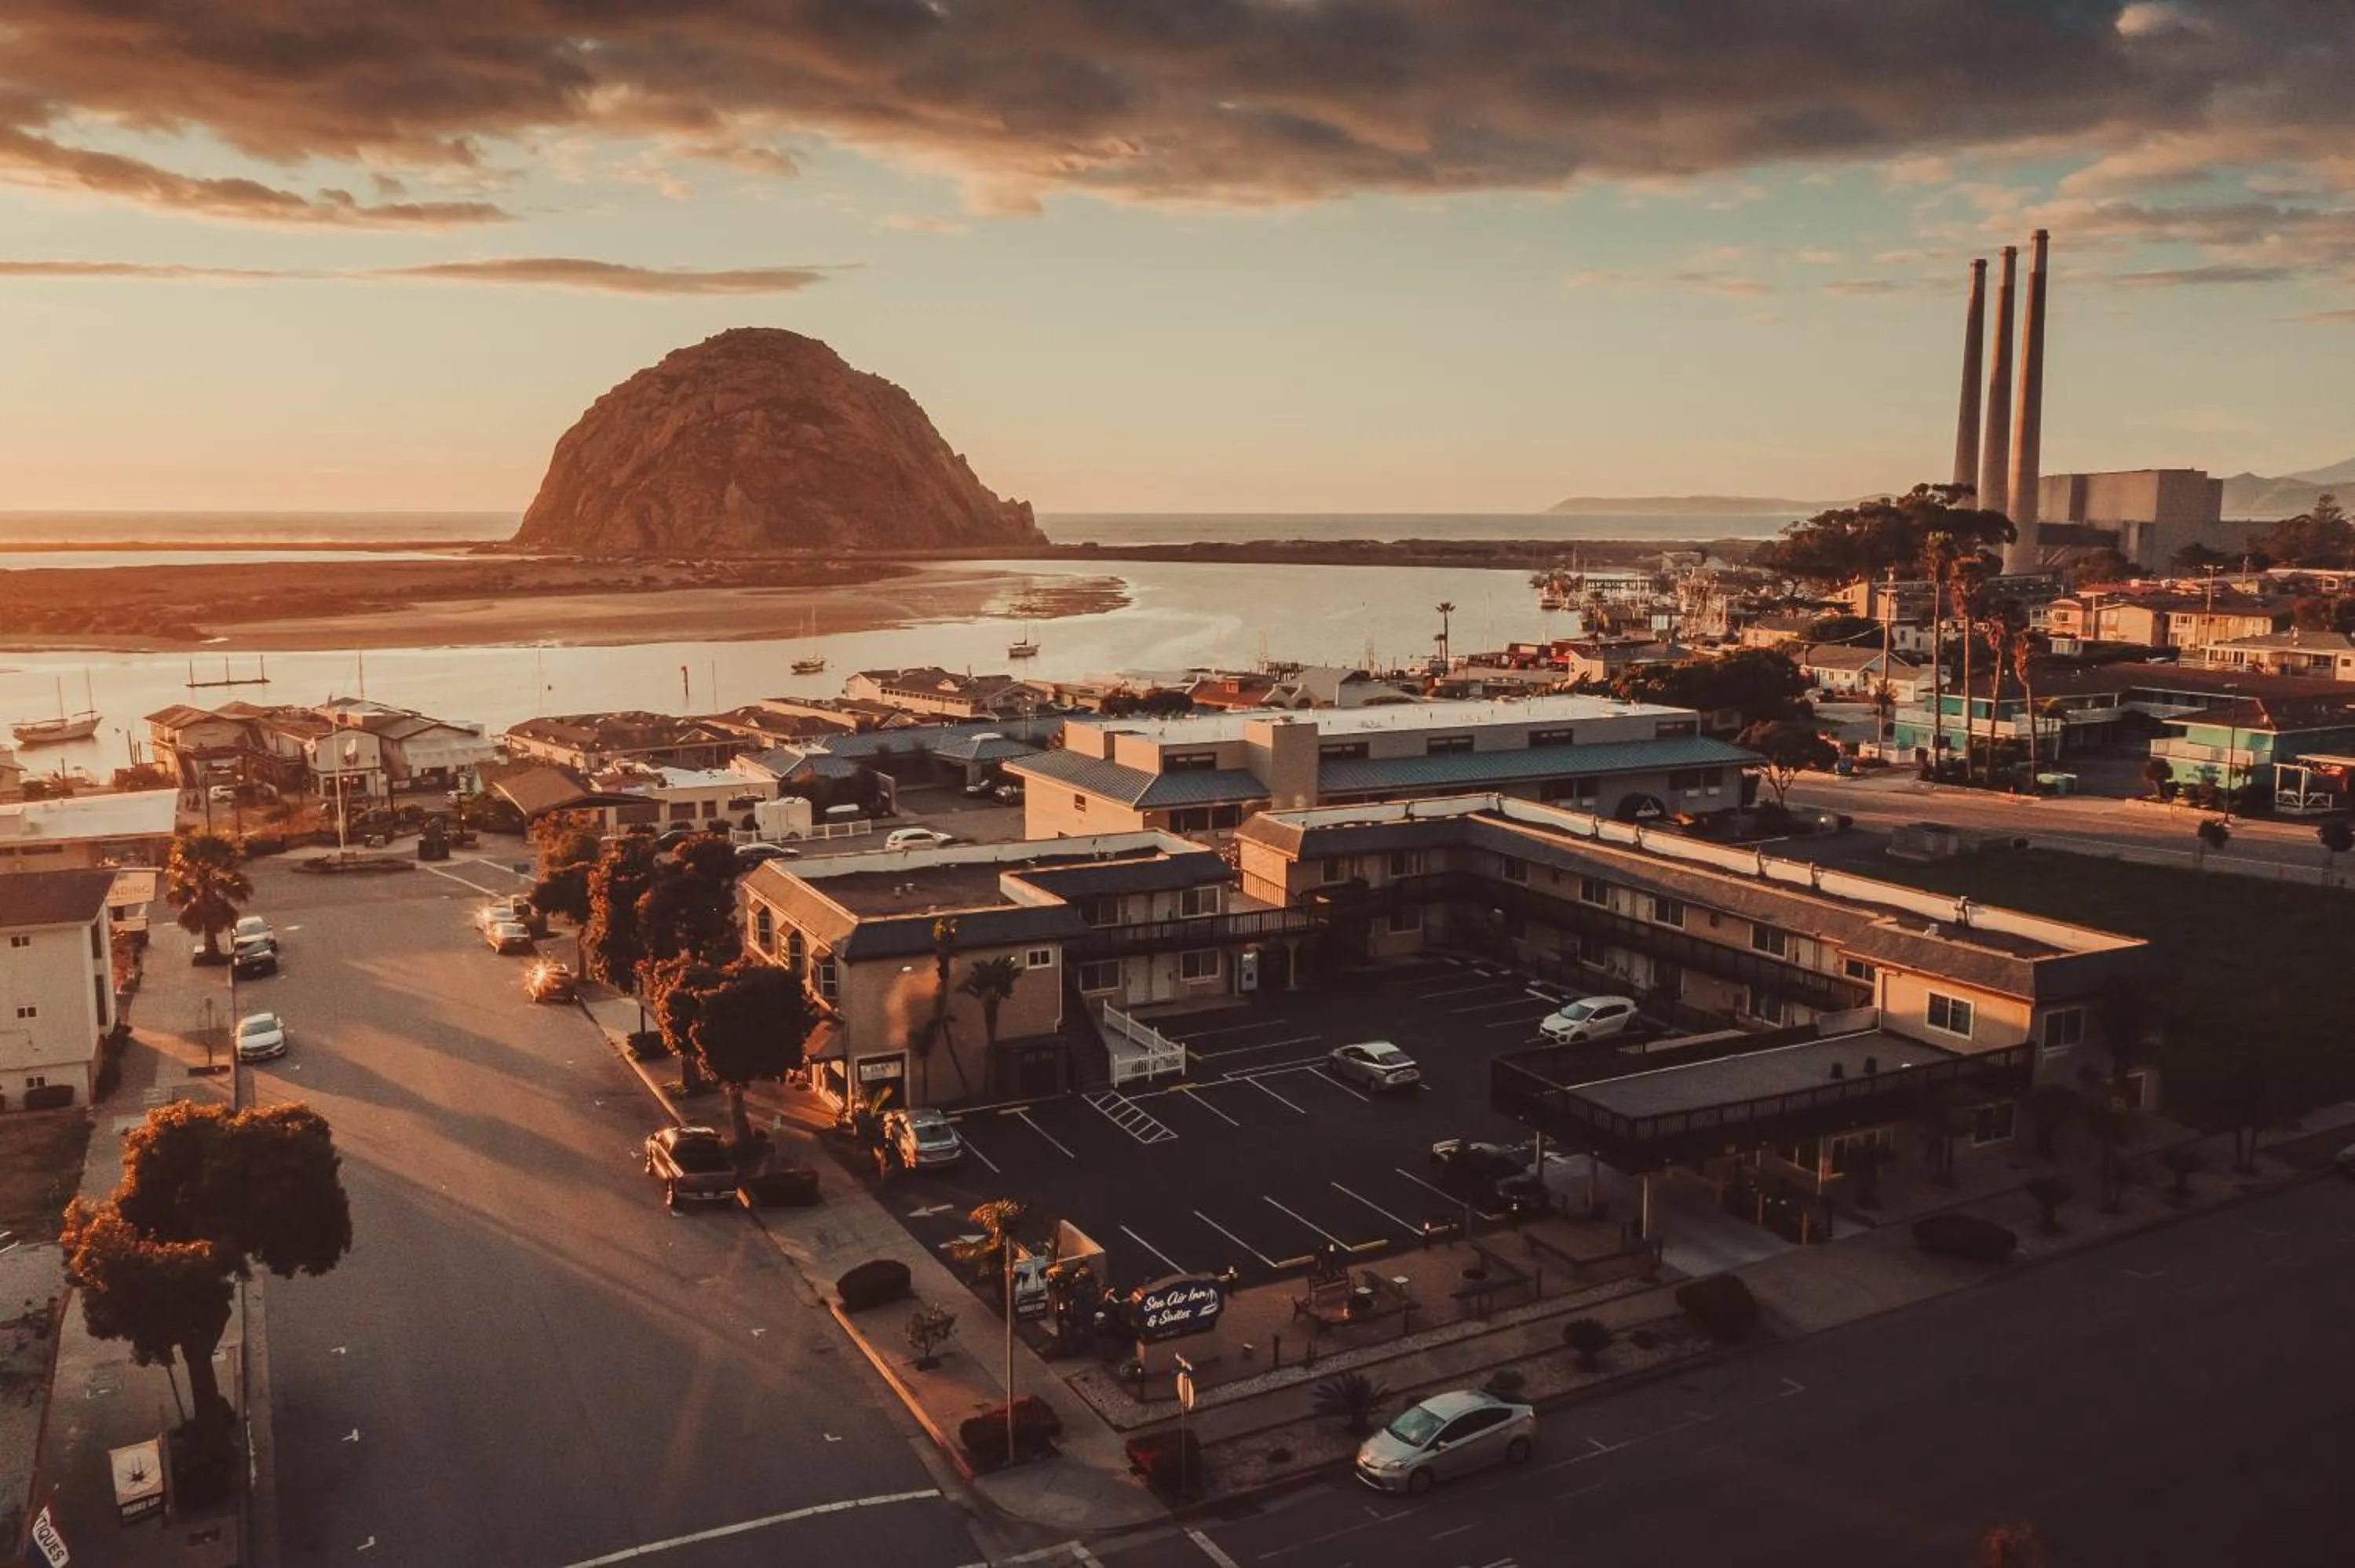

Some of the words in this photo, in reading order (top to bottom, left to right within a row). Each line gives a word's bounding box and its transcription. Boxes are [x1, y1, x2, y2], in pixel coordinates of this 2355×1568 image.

[1144, 1296, 1166, 1312] Sea
[1167, 1291, 1188, 1307] Air
[1188, 1287, 1207, 1302] Inn
[1147, 1315, 1157, 1327] &
[1158, 1309, 1192, 1326] Suites
